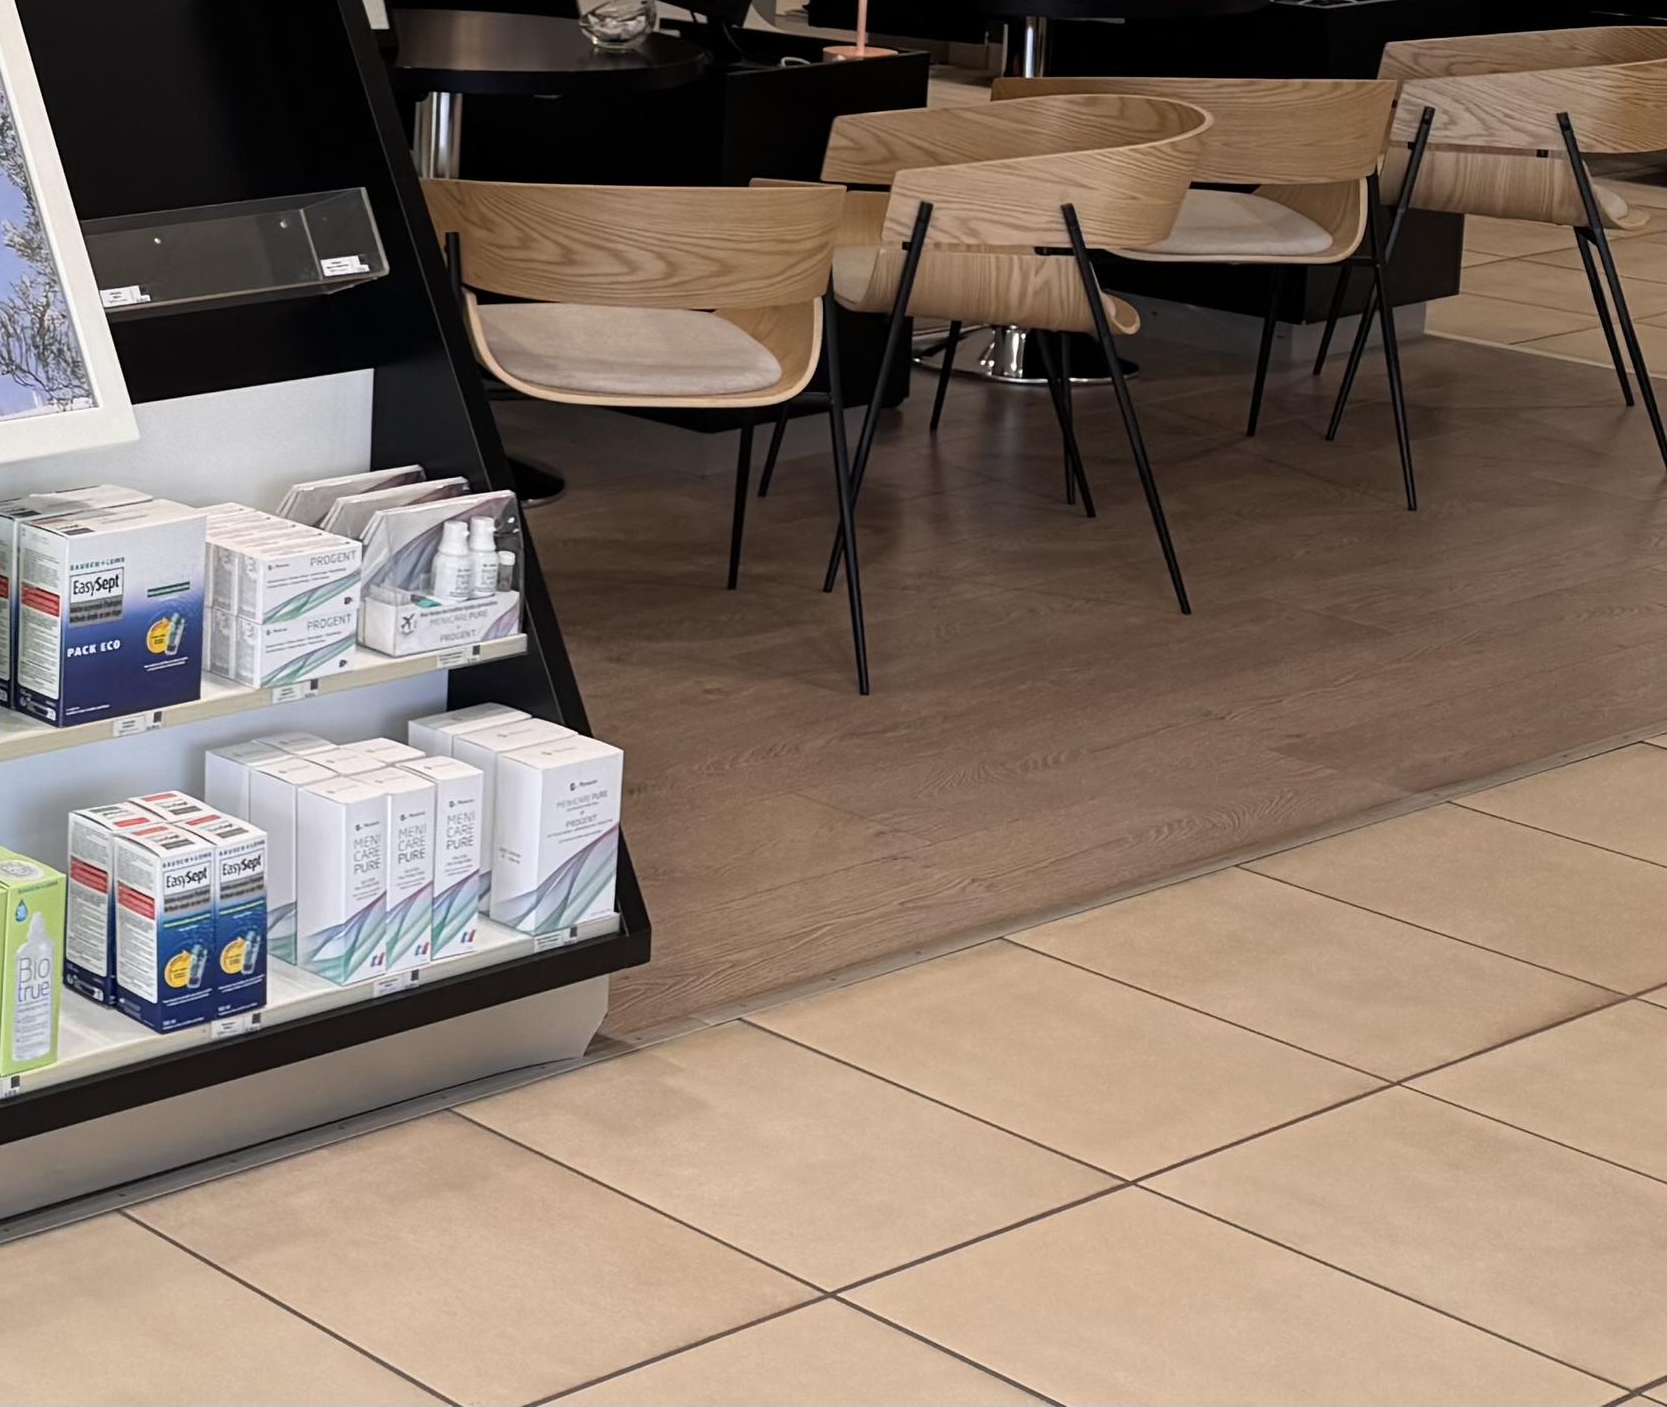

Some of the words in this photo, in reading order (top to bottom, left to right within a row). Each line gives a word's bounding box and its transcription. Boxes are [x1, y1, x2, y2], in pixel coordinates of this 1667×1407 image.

[310, 550, 358, 566] PROGENT
[73, 573, 120, 596] EasySept
[306, 614, 352, 631] PROGENT
[67, 643, 97, 658] PACK
[100, 640, 121, 653] ECO
[446, 823, 474, 838] CARE
[446, 834, 474, 851] PURE
[354, 847, 382, 862] CARE
[222, 854, 262, 876] EasySept
[354, 858, 382, 875] PURE
[166, 866, 208, 888] EasySept
